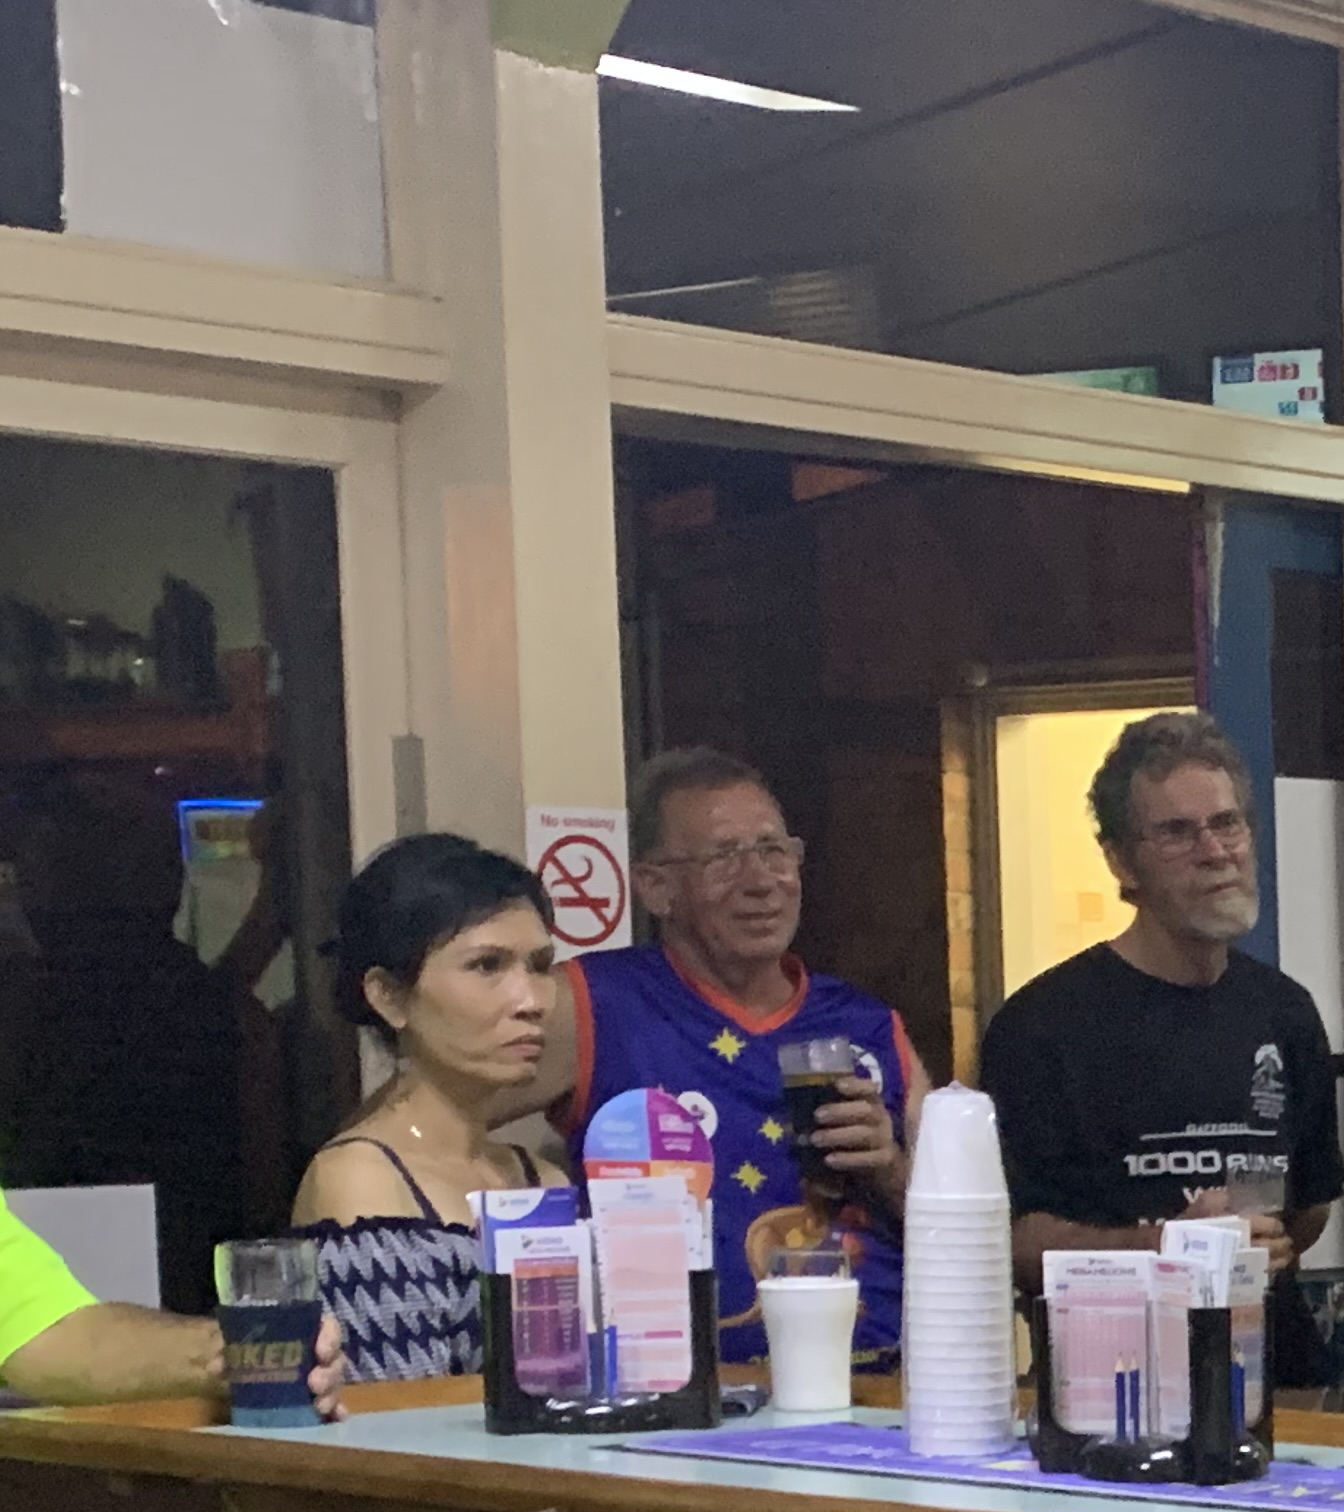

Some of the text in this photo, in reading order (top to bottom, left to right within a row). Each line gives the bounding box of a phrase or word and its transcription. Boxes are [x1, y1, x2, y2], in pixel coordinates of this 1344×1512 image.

[541, 813, 616, 832] No smoking
[1123, 1150, 1289, 1176] 1000 RUNS
